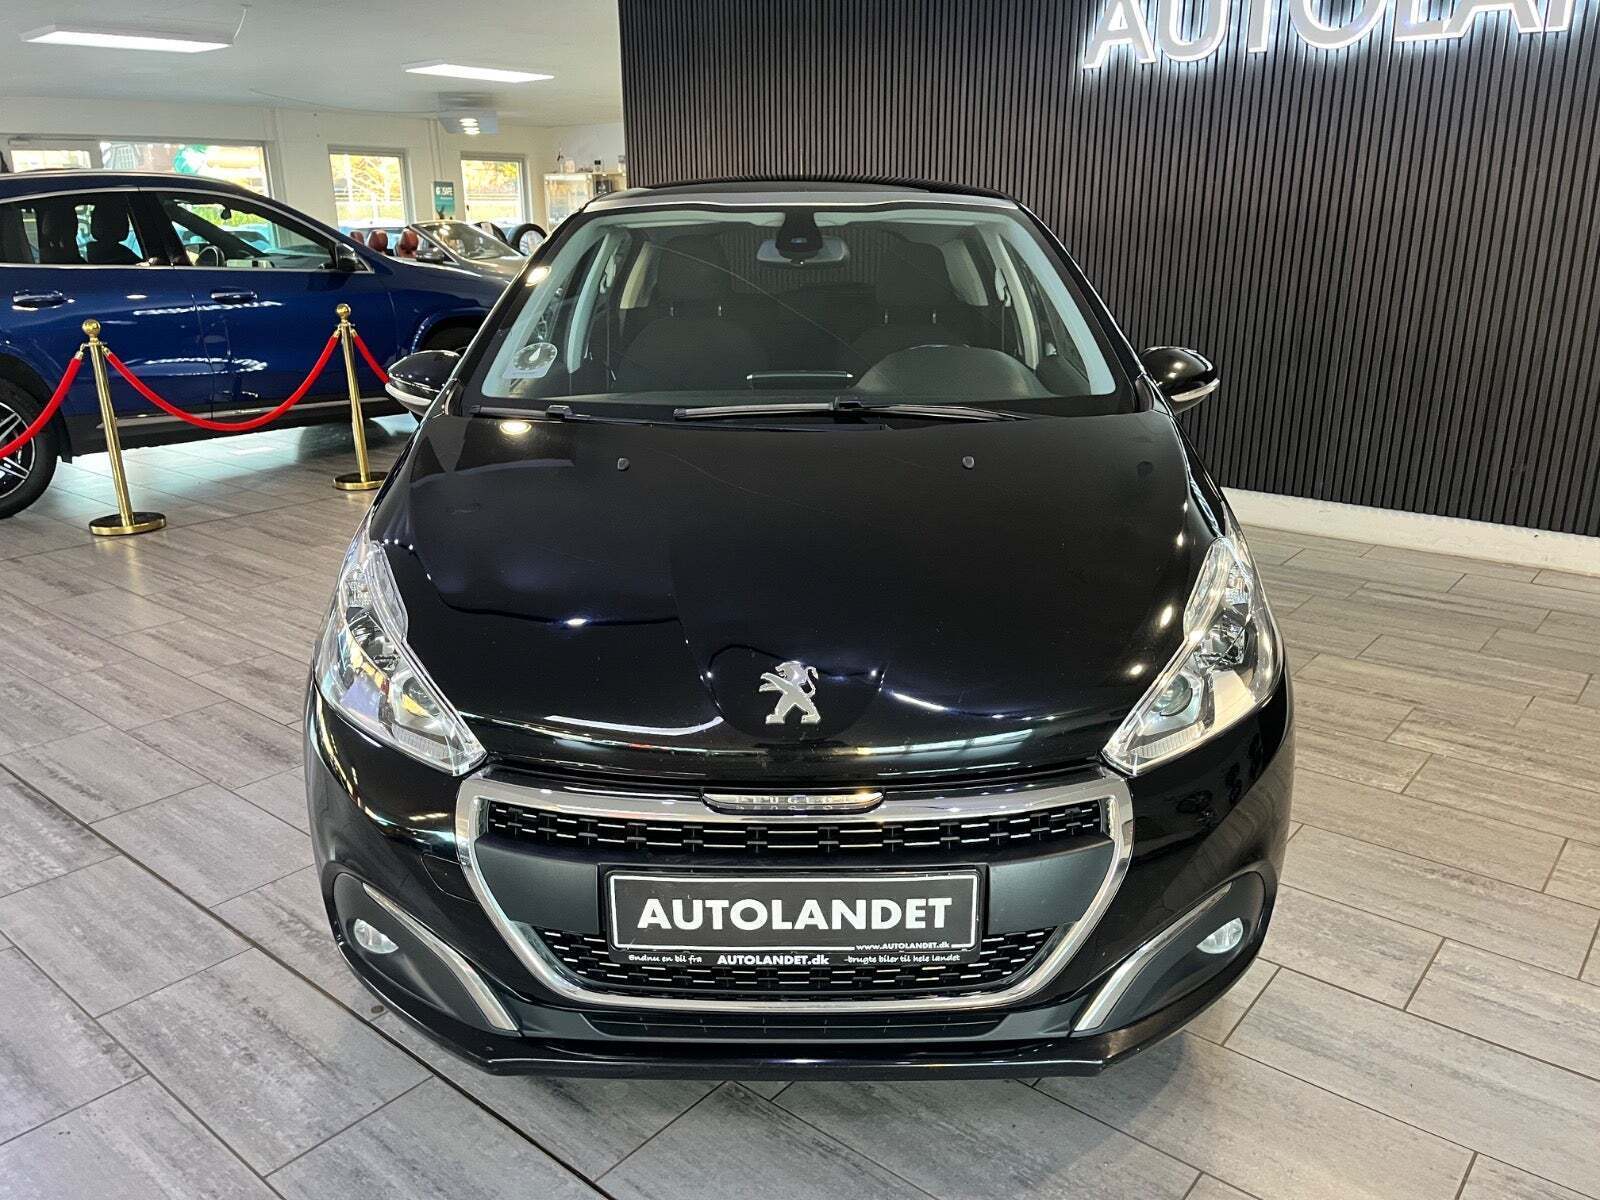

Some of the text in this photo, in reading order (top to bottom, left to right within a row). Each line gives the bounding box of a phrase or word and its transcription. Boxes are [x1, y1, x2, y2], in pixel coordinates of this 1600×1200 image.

[637, 897, 953, 931] AUTOLANDET
[856, 942, 950, 951] www.AUTOLANDET.dk
[675, 954, 687, 963] bil
[688, 955, 702, 965] fra
[717, 954, 829, 966] AUTOLANDET.dk
[879, 955, 899, 963] biler
[900, 954, 911, 963] til
[913, 955, 931, 963] hele
[932, 953, 961, 963] landet
